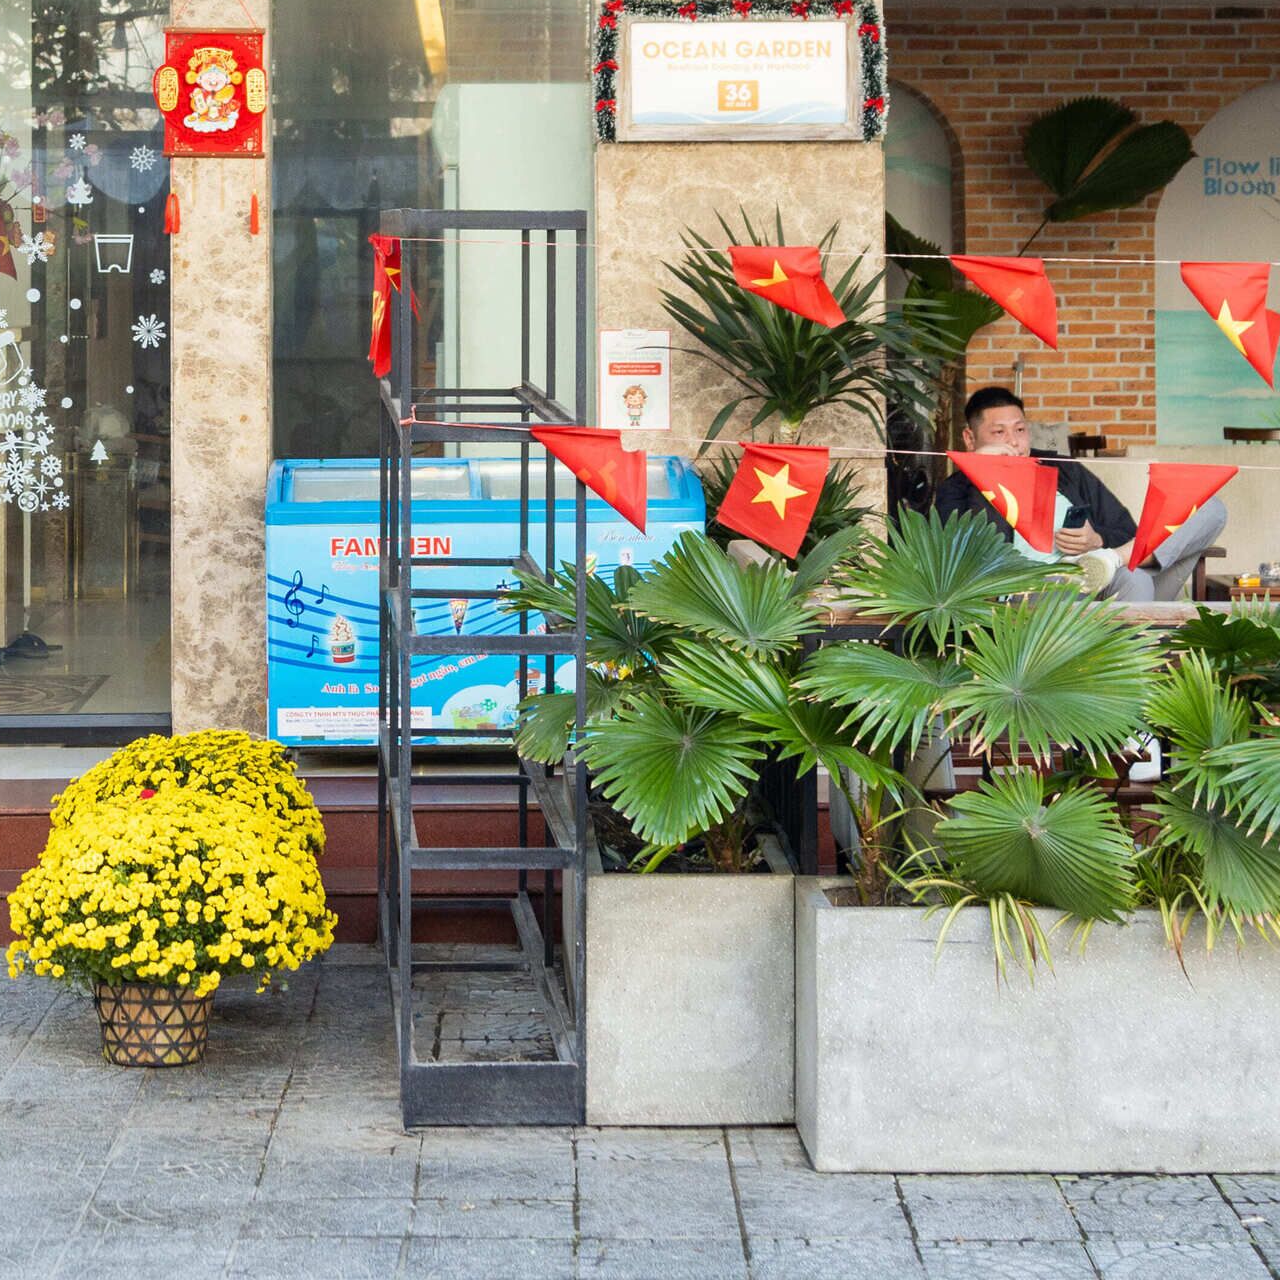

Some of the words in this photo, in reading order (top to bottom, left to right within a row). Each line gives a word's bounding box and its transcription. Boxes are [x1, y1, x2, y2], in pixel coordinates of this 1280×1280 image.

[642, 40, 729, 59] OCEAN
[734, 40, 832, 59] GARDEN
[724, 83, 752, 101] 36
[1203, 157, 1261, 177] Flow
[1203, 177, 1276, 196] Bloom
